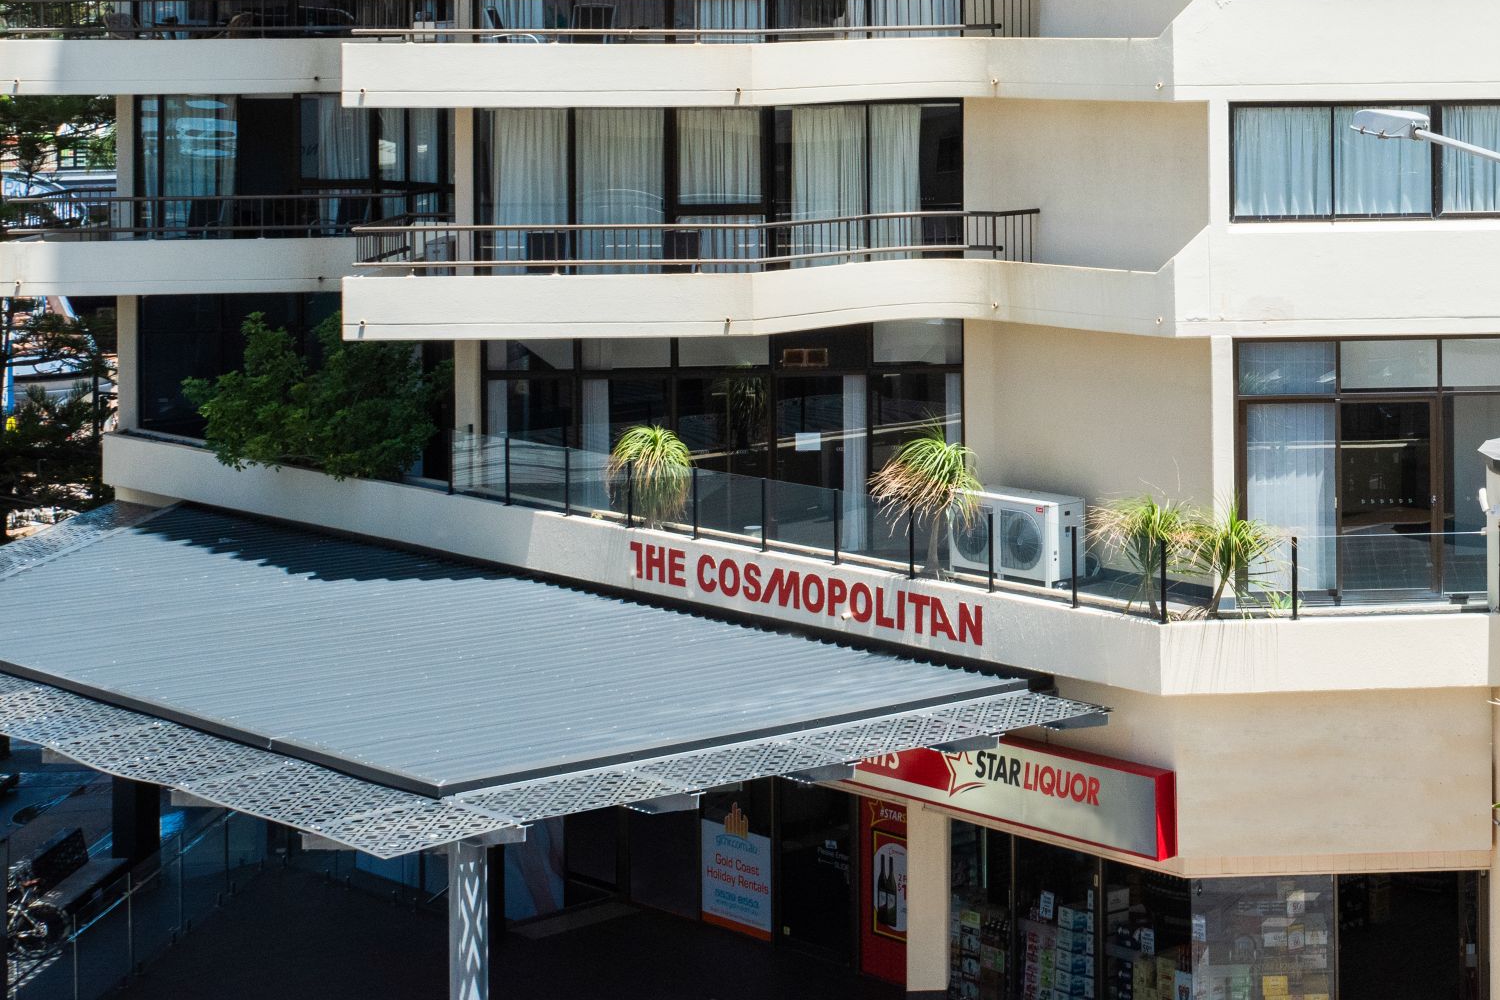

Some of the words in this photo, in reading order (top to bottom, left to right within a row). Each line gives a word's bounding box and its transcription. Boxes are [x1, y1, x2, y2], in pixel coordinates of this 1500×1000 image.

[629, 541, 687, 588] THE
[696, 553, 983, 646] COSMOPOLITAN
[975, 750, 1021, 787] STAR
[1023, 761, 1101, 806] LIQUOR
[706, 865, 736, 887] Holiday
[737, 875, 769, 895] Rentals
[715, 853, 733, 869] Gold
[735, 860, 760, 876] Coast
